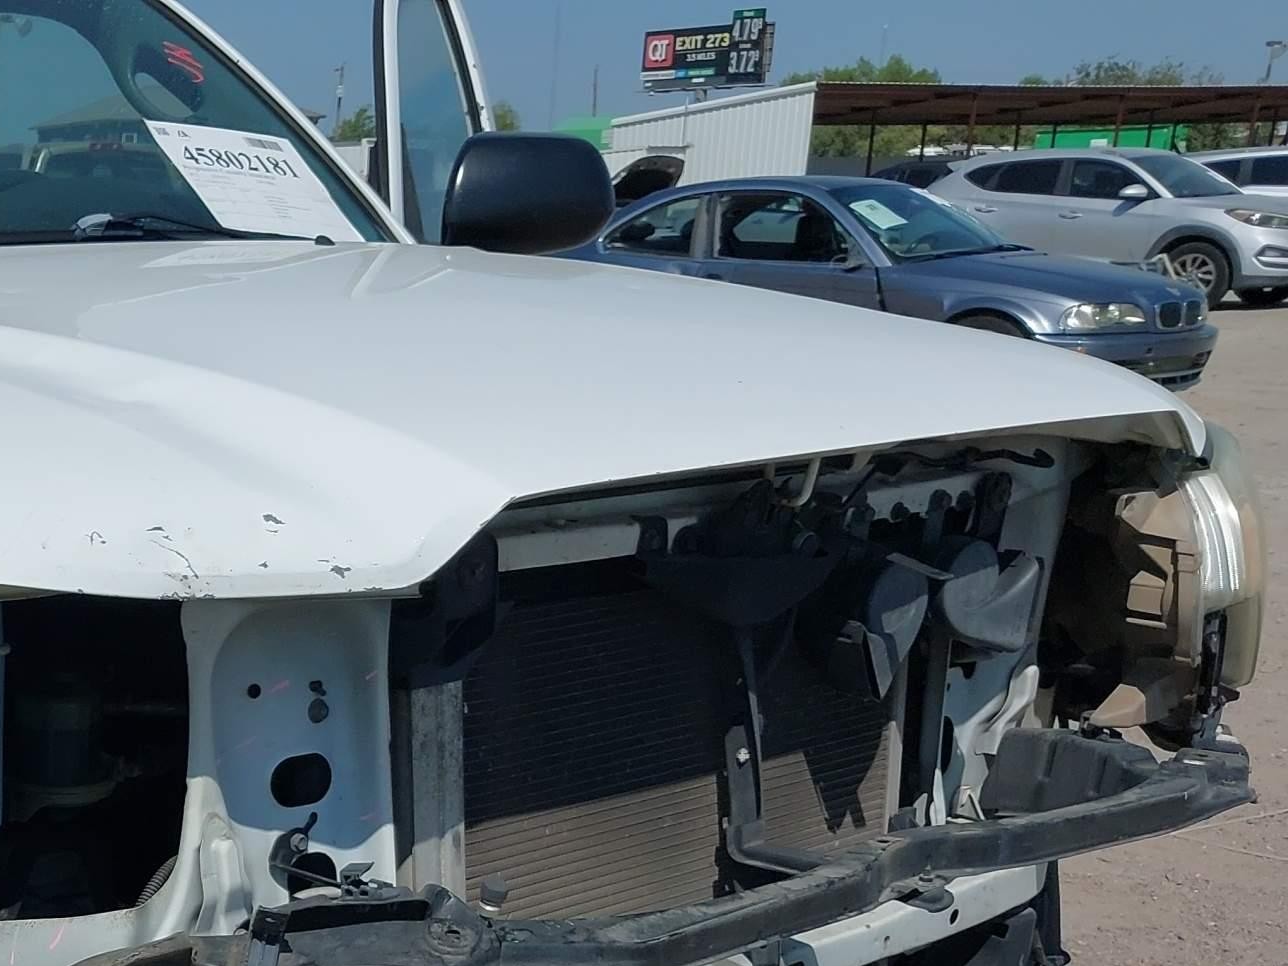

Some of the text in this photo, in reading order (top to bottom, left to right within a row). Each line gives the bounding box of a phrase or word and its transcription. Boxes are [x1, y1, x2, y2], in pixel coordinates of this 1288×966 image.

[648, 39, 669, 62] QT
[675, 32, 730, 50] EXIT 273
[183, 146, 300, 178] 45802181
